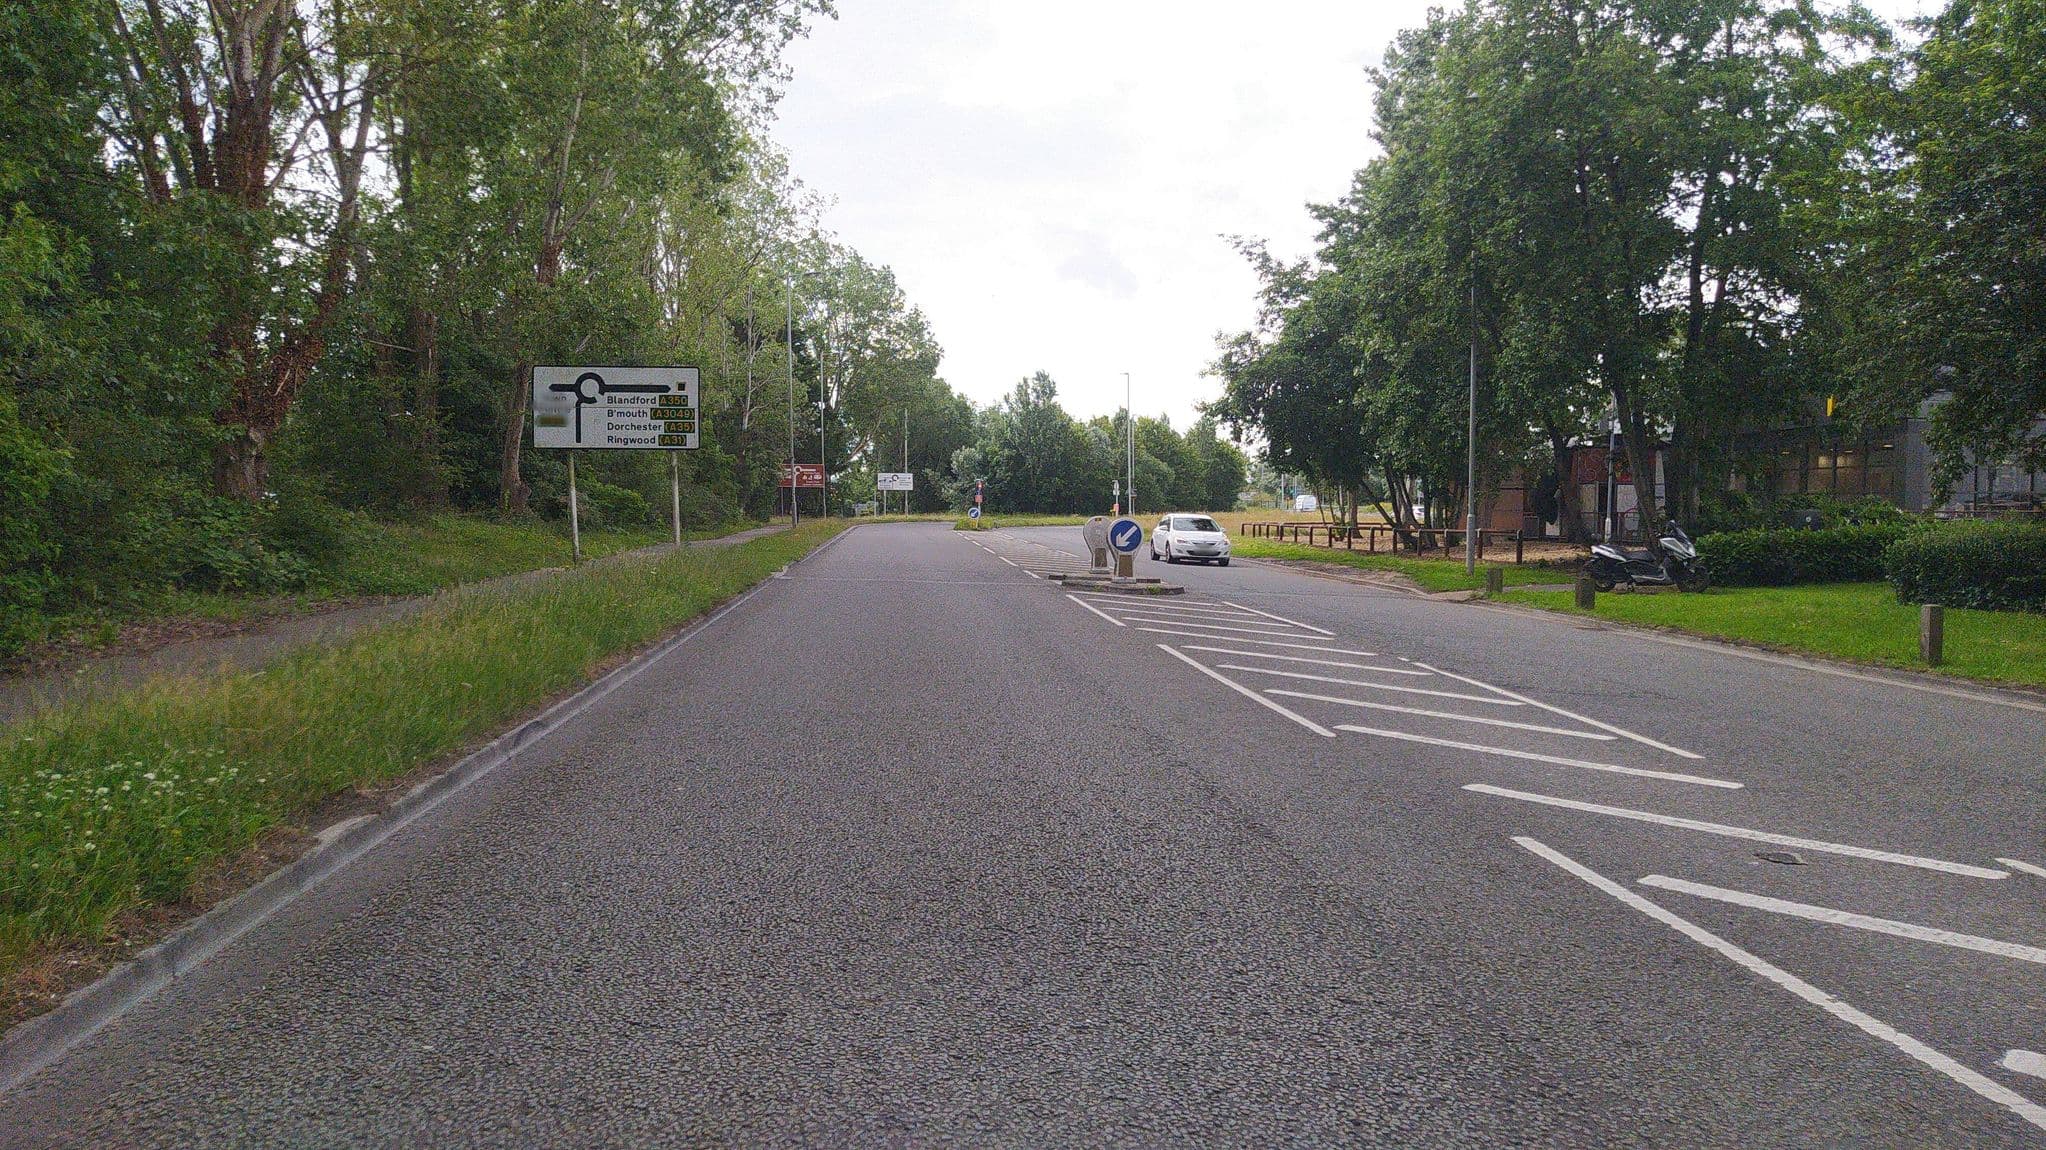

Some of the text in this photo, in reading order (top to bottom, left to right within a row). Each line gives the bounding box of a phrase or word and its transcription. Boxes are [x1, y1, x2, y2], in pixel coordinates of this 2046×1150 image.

[607, 396, 688, 405] Blandford A350
[607, 409, 695, 419] B'mouth (A3049)
[607, 422, 695, 432] Dorchester (A35)
[607, 436, 686, 445] Ringwood (A31)
